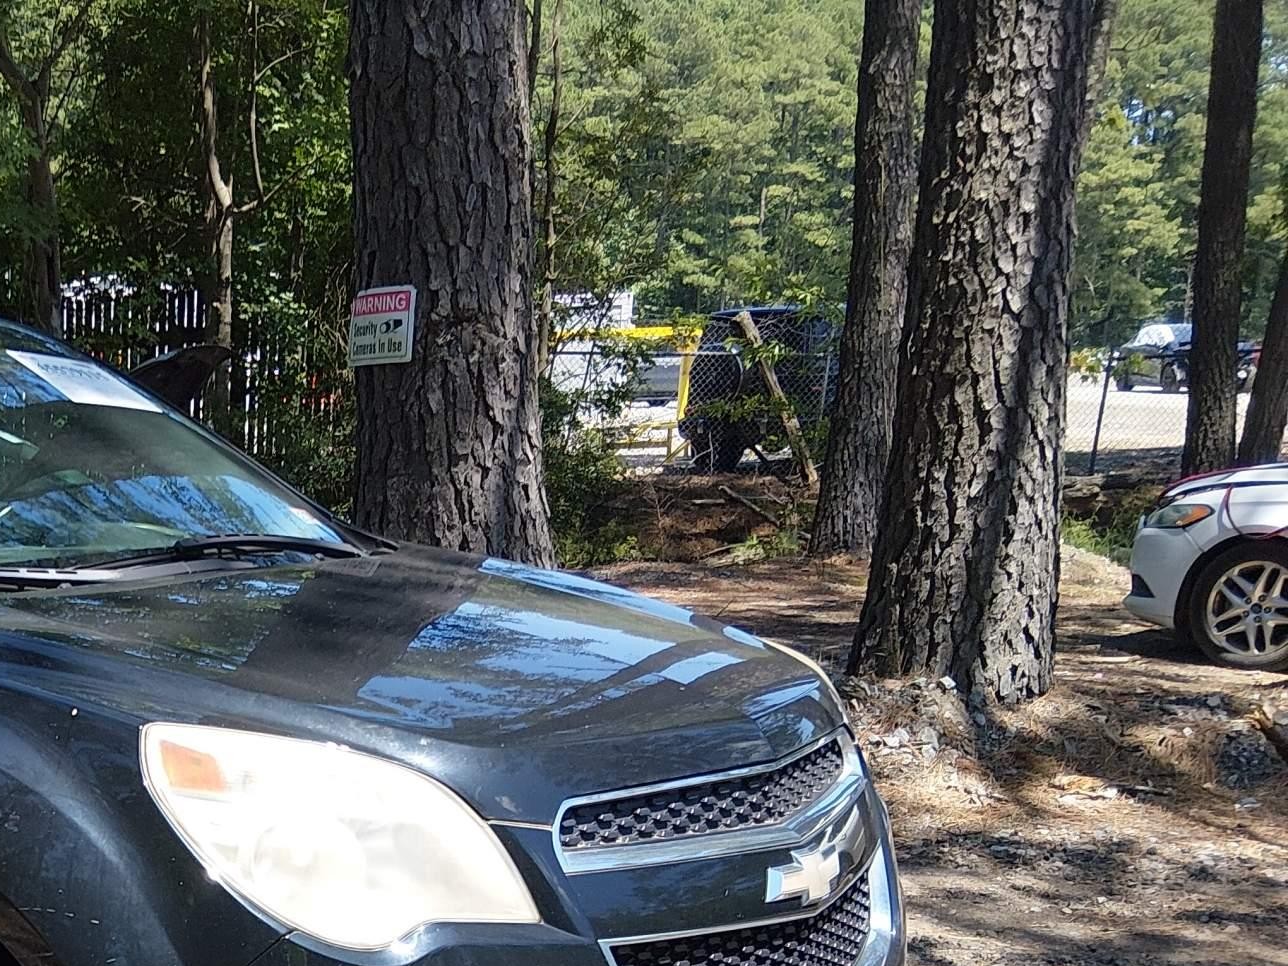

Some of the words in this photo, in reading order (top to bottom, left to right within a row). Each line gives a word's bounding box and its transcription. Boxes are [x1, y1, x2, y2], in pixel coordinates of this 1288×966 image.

[354, 294, 406, 313] WARNING
[354, 321, 378, 338] Security
[352, 342, 377, 355] Cameras
[378, 338, 386, 353] In
[387, 338, 402, 352] Use
